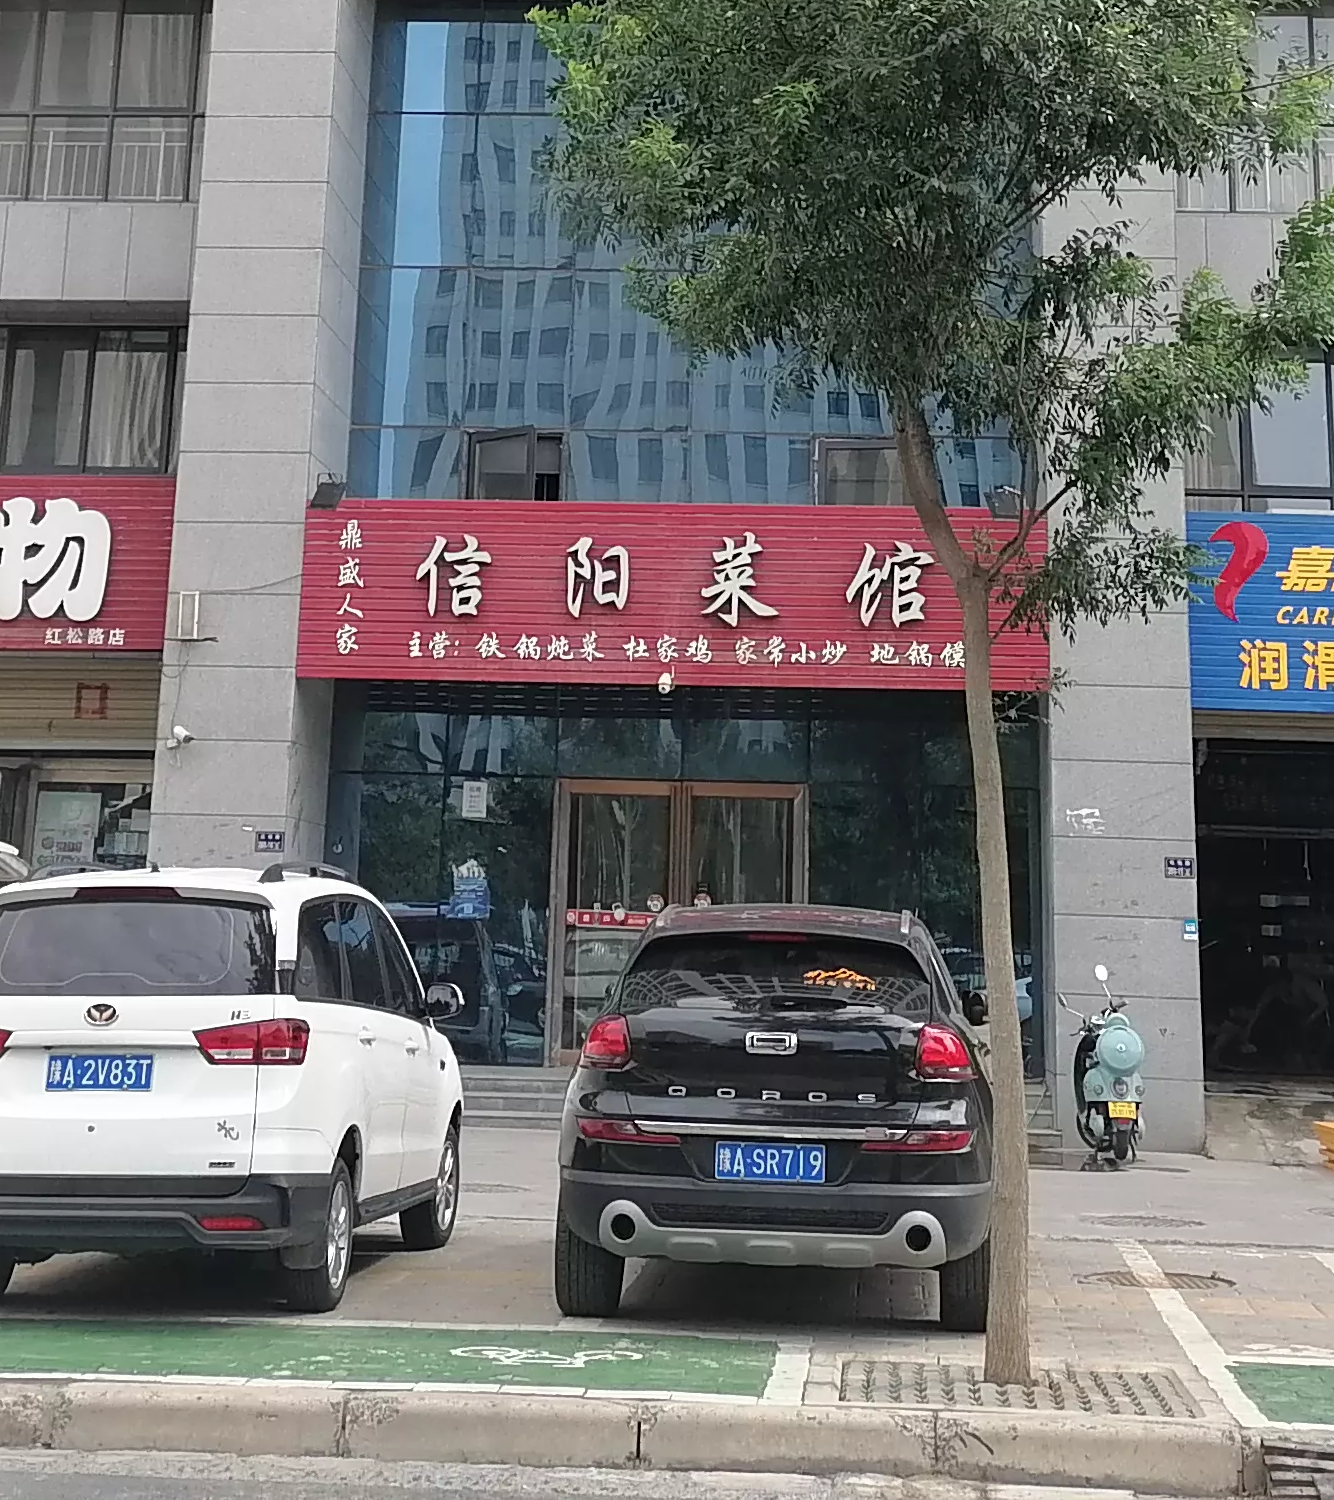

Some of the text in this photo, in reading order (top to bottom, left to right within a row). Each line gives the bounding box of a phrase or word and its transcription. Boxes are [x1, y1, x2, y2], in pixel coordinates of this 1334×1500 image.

[336, 519, 365, 655] 鼎盛人家
[414, 531, 935, 627] 信阳菜馆
[44, 626, 125, 645] 红松路店
[474, 630, 605, 663] 铁锅炖菜
[622, 634, 713, 664] 杜家鸡
[735, 635, 848, 668] 家常小炒
[668, 1086, 876, 1103] QOROS
